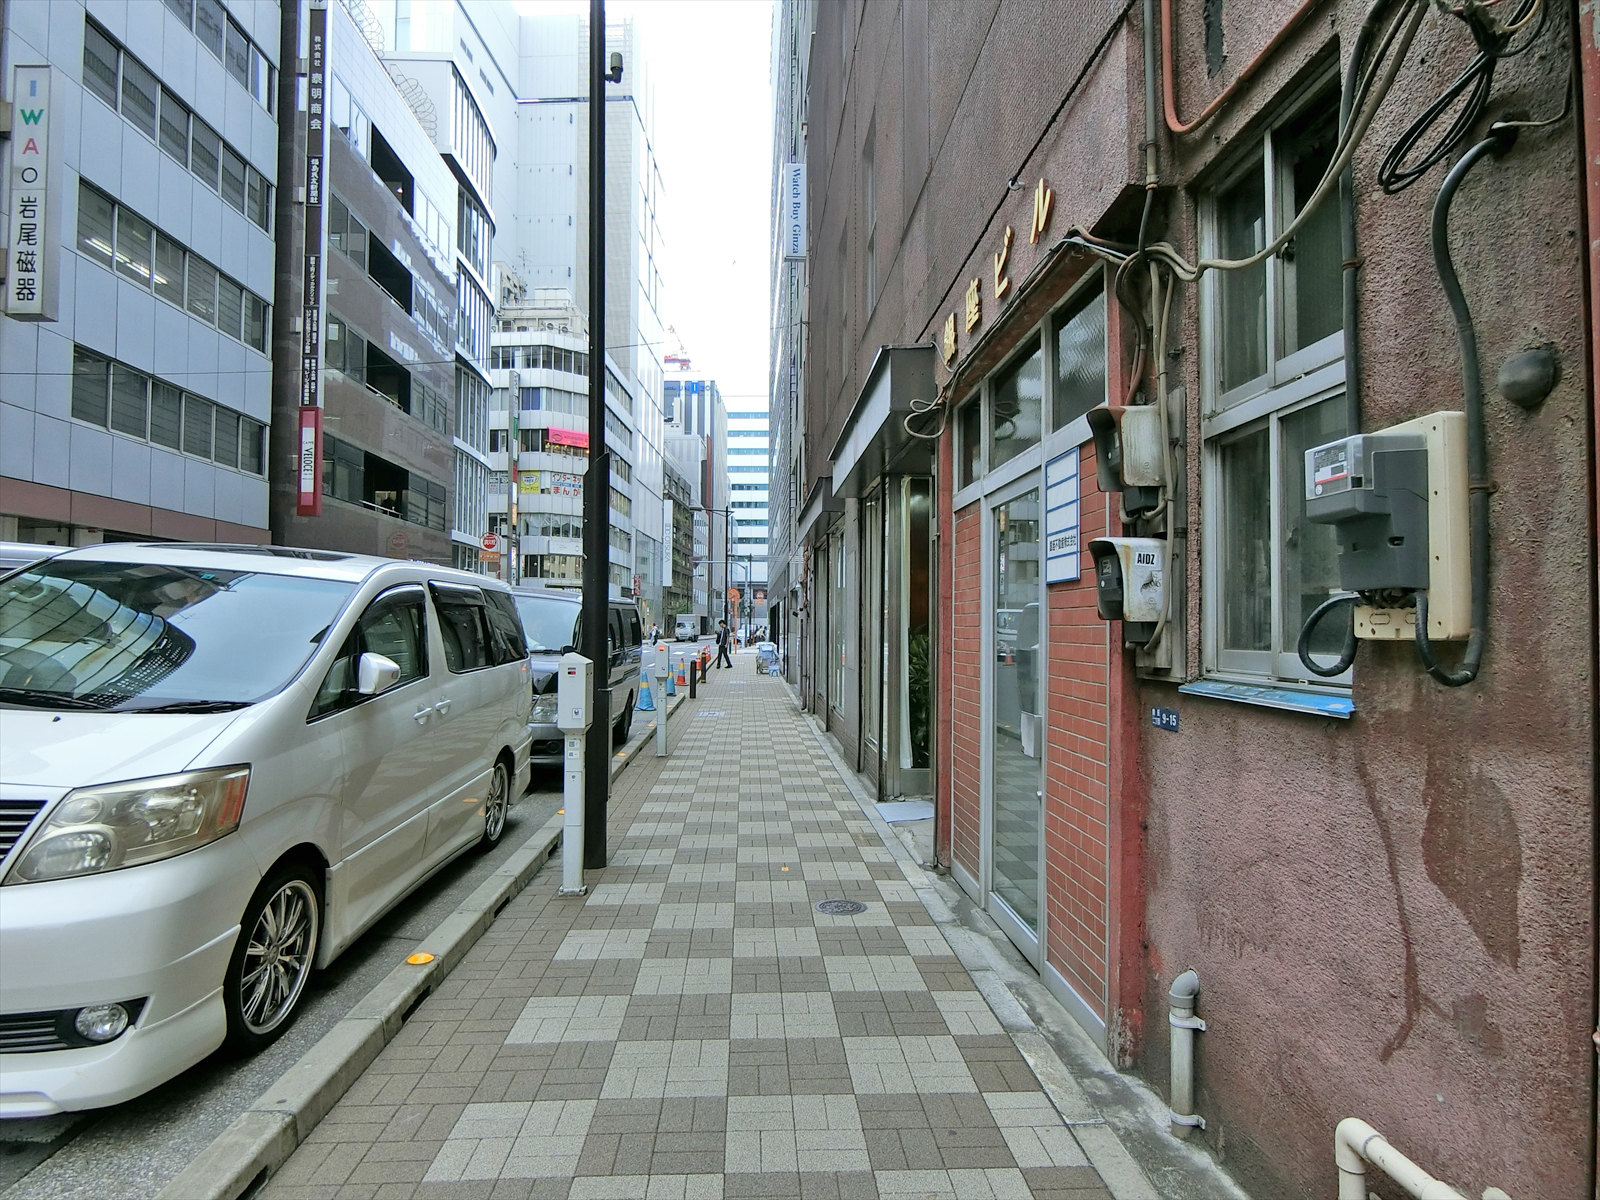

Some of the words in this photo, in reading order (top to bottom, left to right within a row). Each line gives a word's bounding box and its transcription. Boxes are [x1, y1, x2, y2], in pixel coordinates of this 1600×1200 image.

[314, 35, 322, 67] 株式会社
[310, 72, 323, 130] 泰明商会
[20, 80, 44, 184] IWAO
[792, 168, 801, 199] Watch
[790, 202, 801, 220] Buy
[15, 195, 38, 302] 岩尾磁器
[792, 224, 801, 254] Ginza
[303, 447, 313, 472] VELOCE
[1136, 553, 1155, 565] AIDZ
[1161, 713, 1177, 726] 9-15
